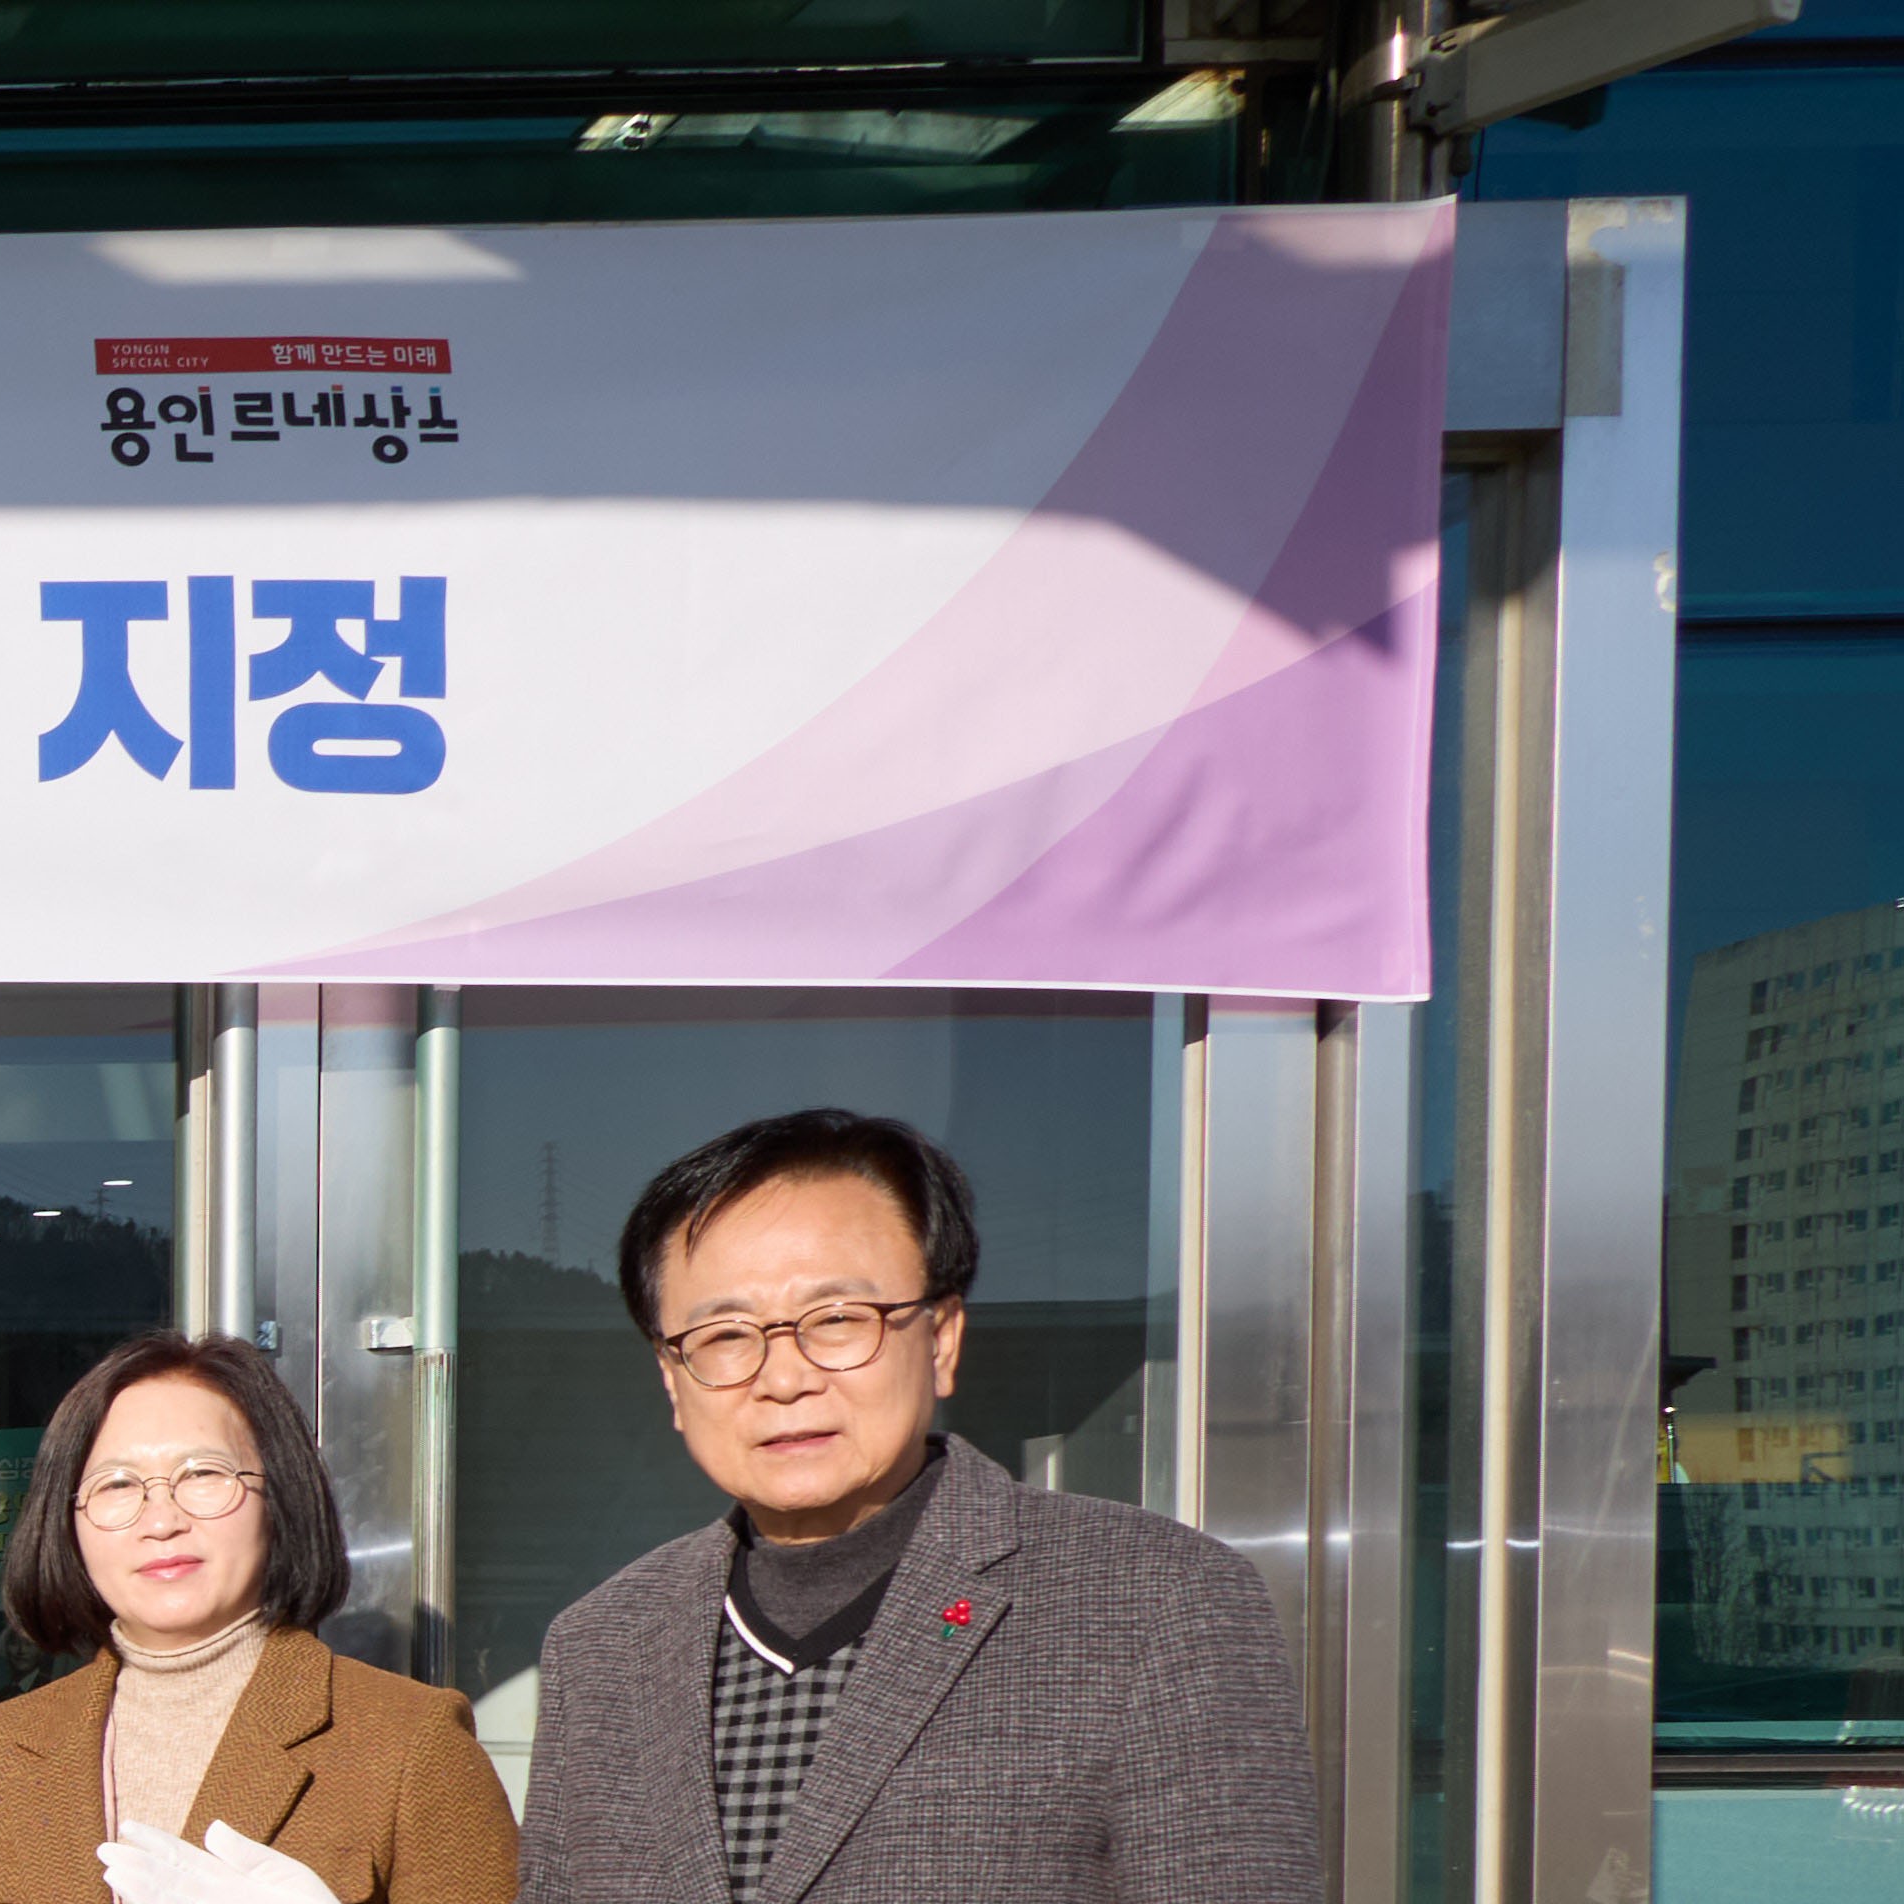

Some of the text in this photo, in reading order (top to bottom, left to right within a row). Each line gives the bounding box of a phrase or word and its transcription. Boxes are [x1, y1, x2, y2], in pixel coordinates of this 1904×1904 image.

[112, 344, 169, 355] YONGIN
[271, 344, 437, 366] 함께 만드는 미래
[112, 356, 210, 368] SPECIAL CITY
[40, 576, 447, 794] 지정
